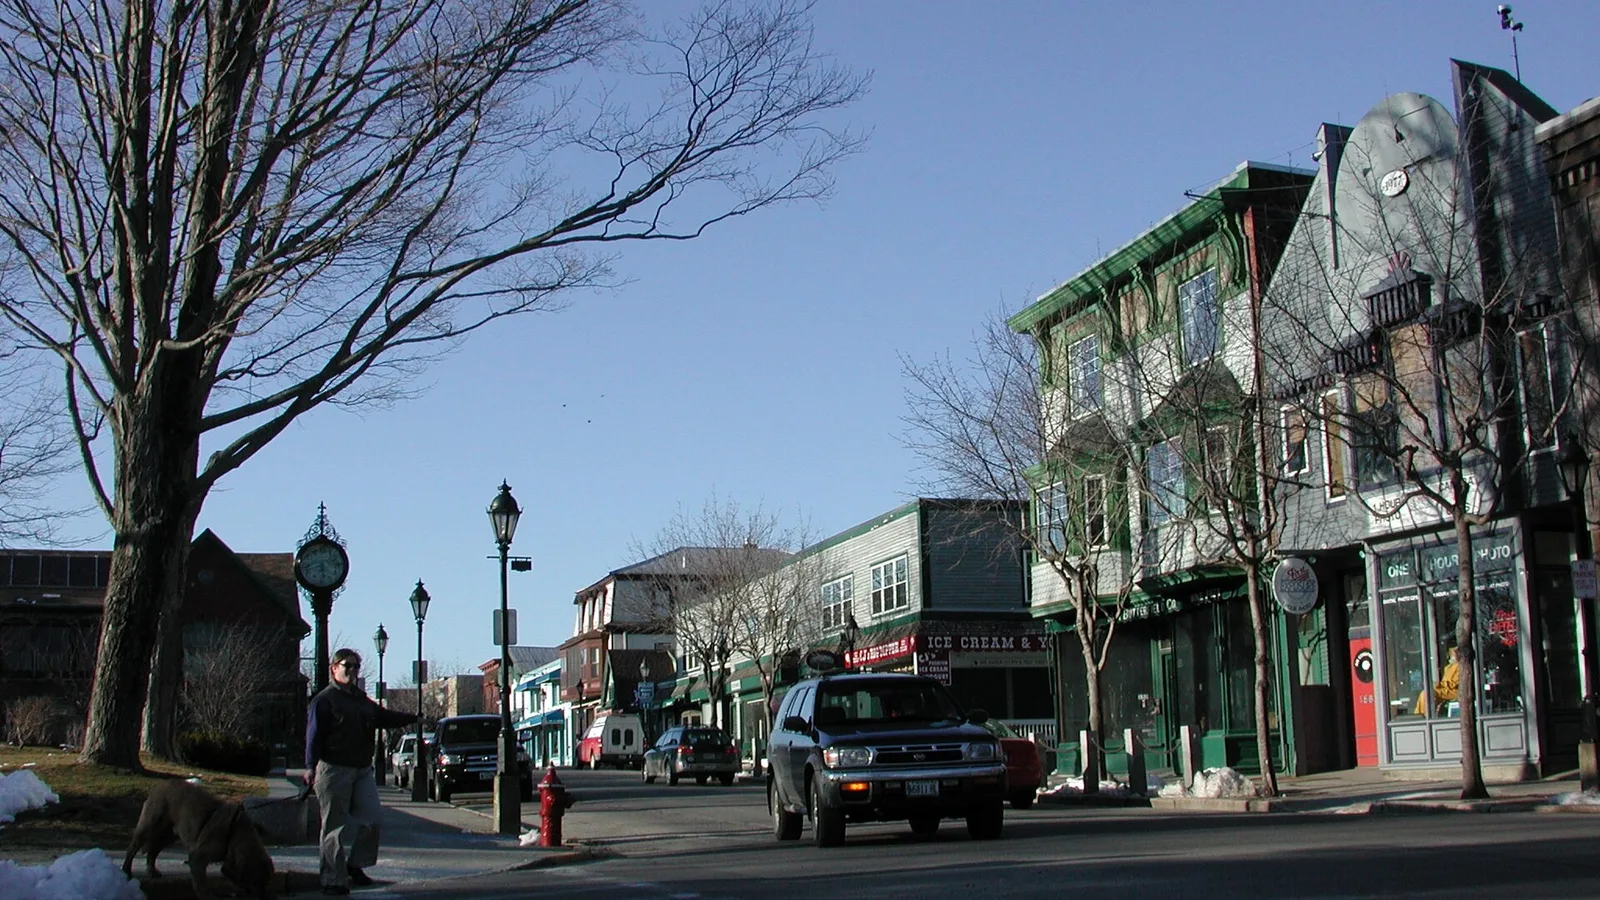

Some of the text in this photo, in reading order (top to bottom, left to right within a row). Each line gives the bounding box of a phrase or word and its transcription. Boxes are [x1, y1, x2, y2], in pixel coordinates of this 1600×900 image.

[1380, 498, 1401, 511] HOUR
[1387, 545, 1511, 578] ONE HOUR PHOTO
[927, 636, 952, 649] ICE
[960, 636, 1014, 649] CREAM
[1021, 637, 1031, 649] &
